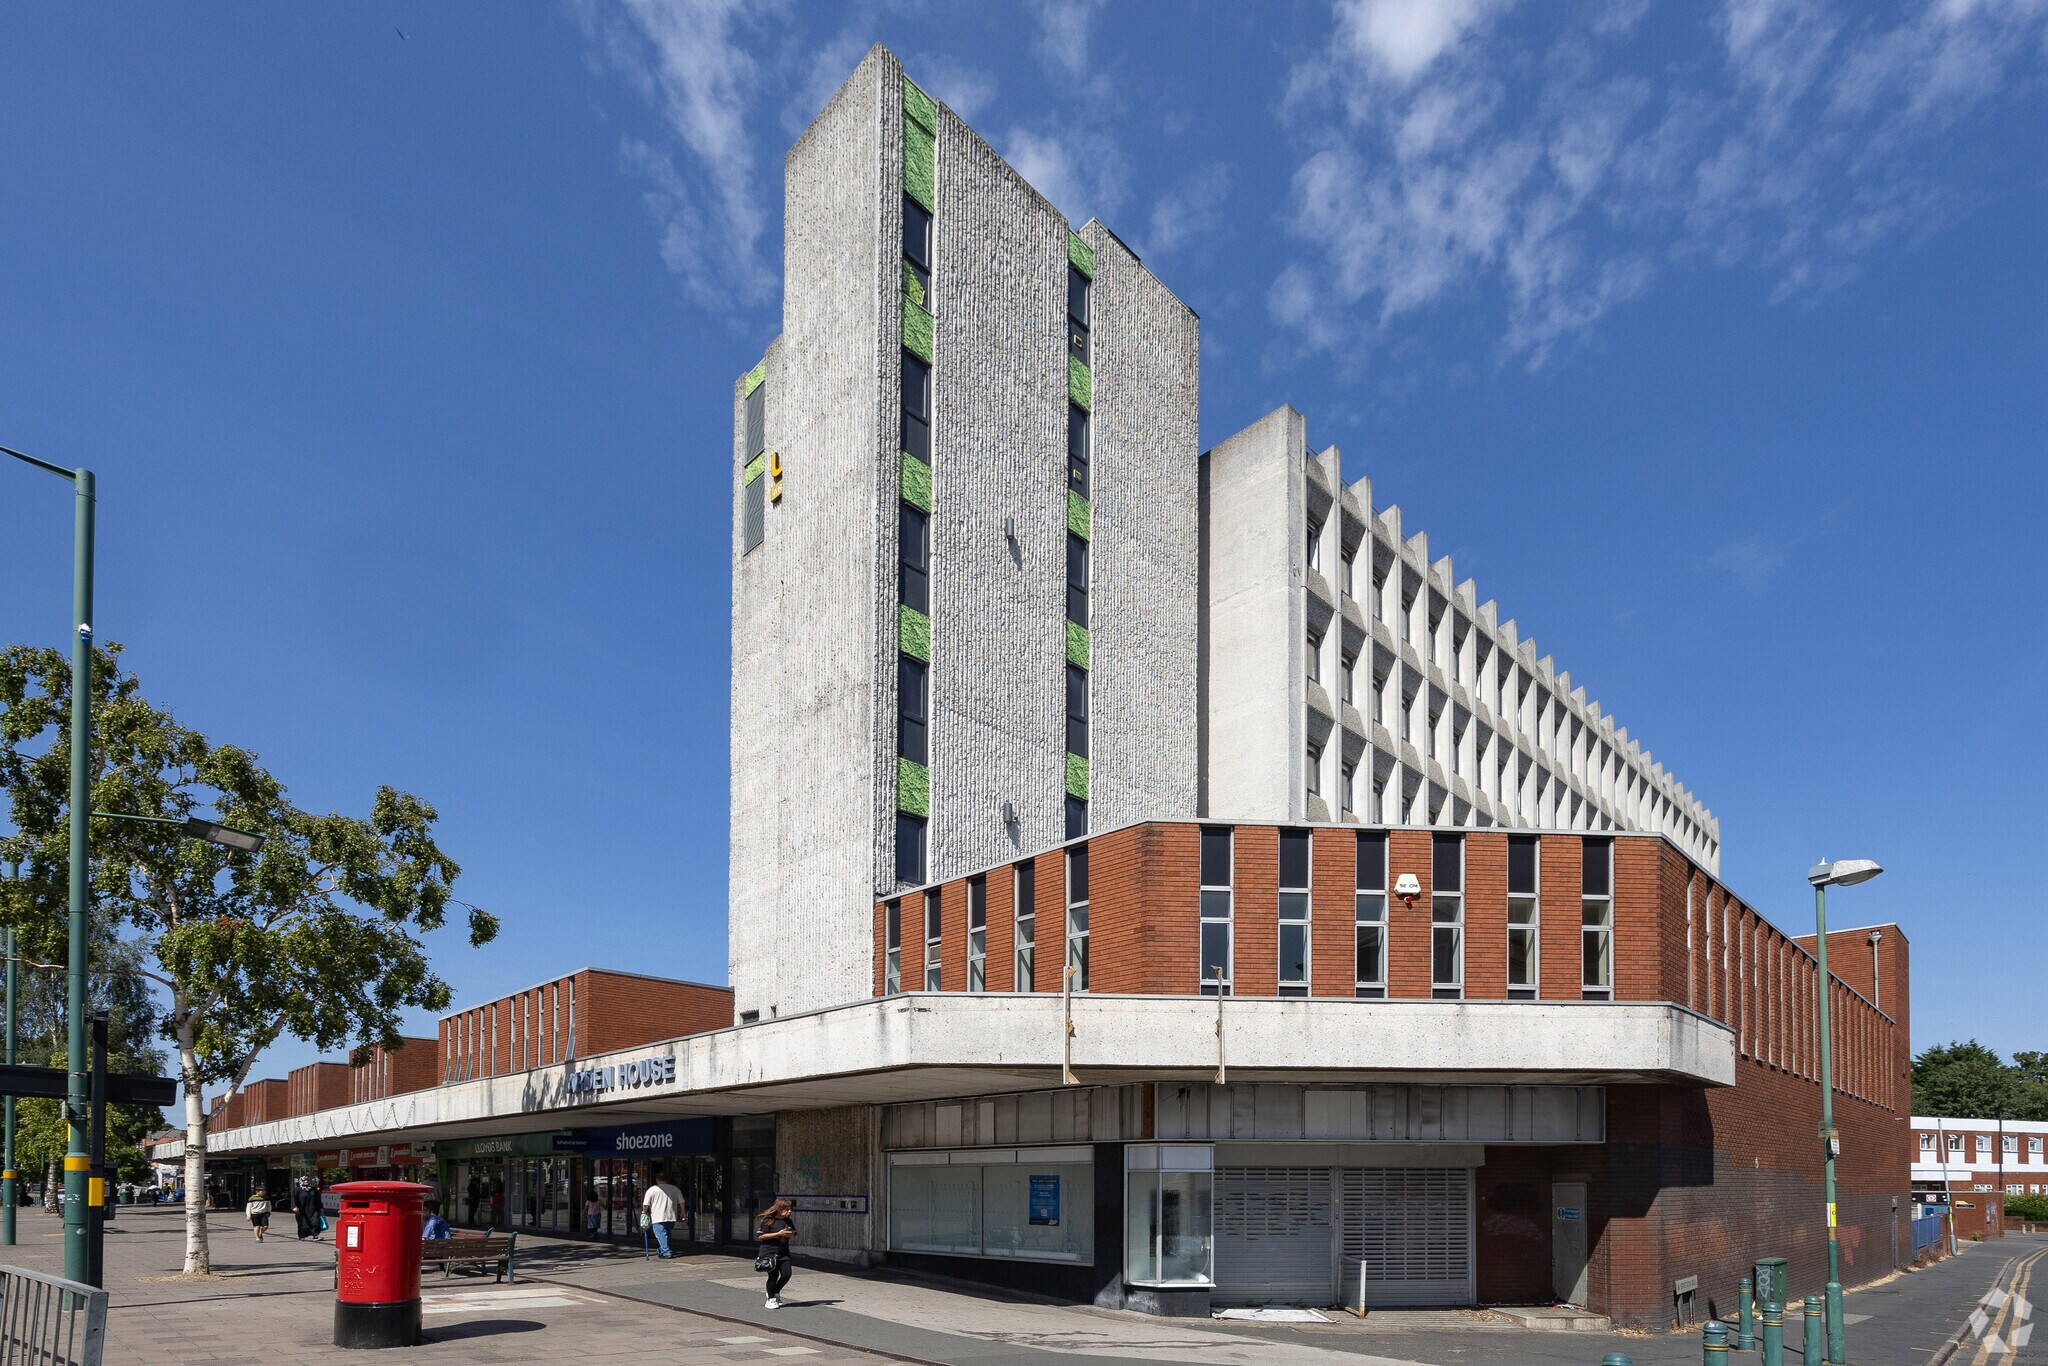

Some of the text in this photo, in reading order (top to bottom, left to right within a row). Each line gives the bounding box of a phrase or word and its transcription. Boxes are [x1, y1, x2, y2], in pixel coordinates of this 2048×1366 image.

[618, 1055, 676, 1087] HOUSE
[495, 1140, 513, 1152] BANK
[616, 1132, 673, 1150] shoezone
